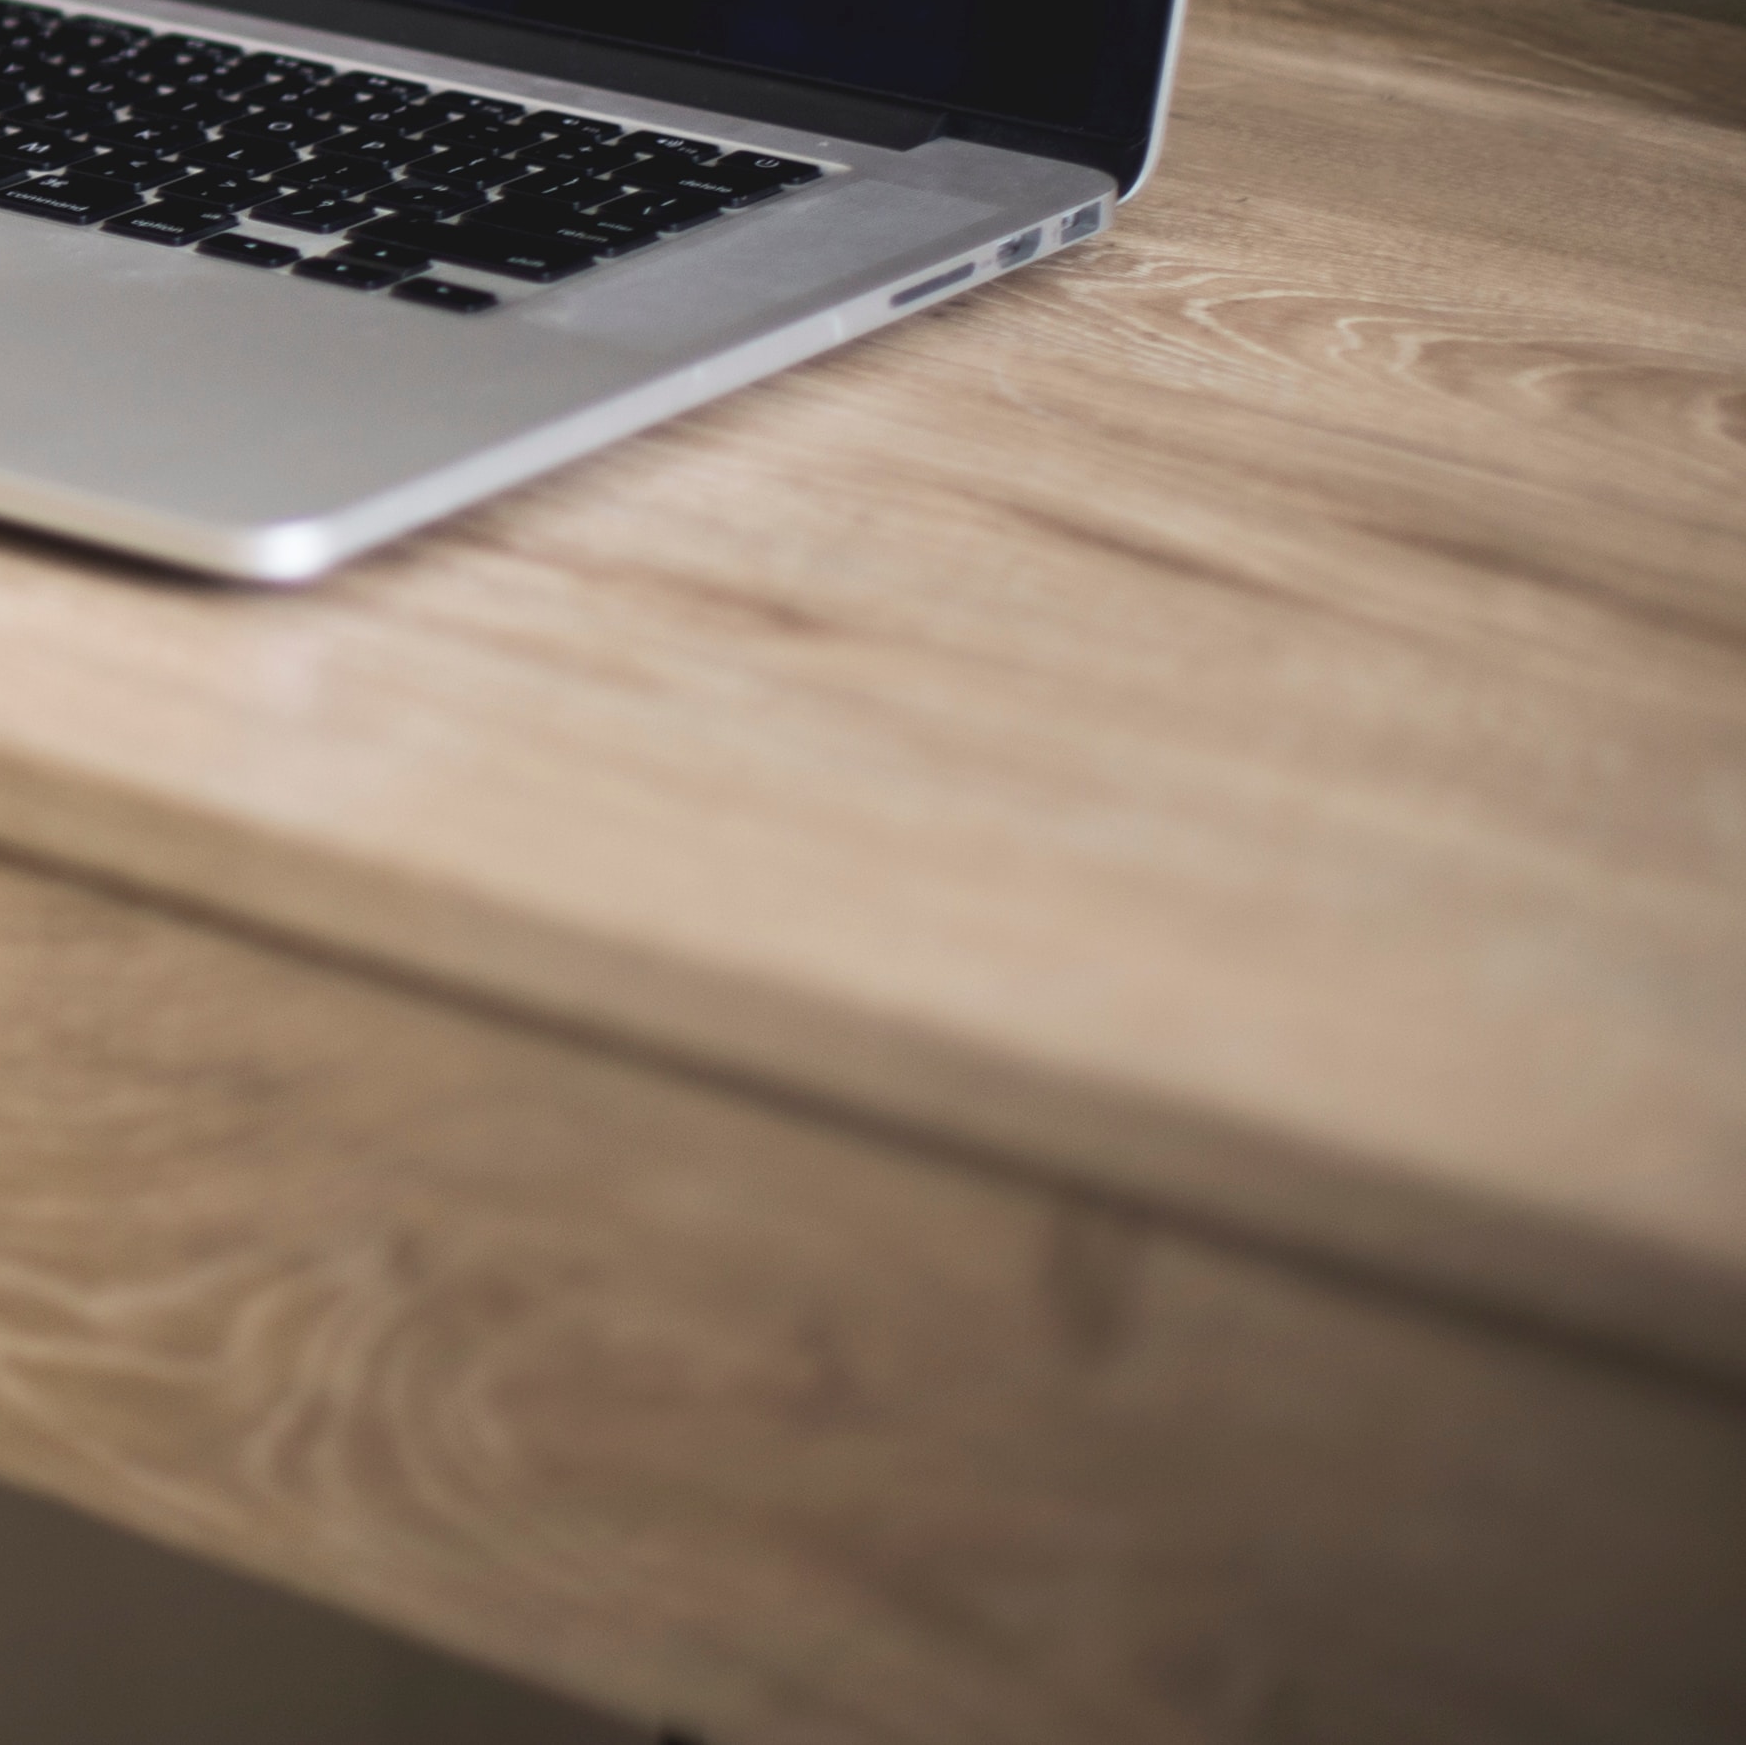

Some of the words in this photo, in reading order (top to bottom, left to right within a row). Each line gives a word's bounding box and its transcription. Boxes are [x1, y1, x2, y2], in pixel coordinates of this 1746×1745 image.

[16, 141, 52, 155] M
[678, 178, 733, 194] delete
[5, 190, 91, 212] command
[130, 217, 186, 234] option
[556, 228, 610, 243] return
